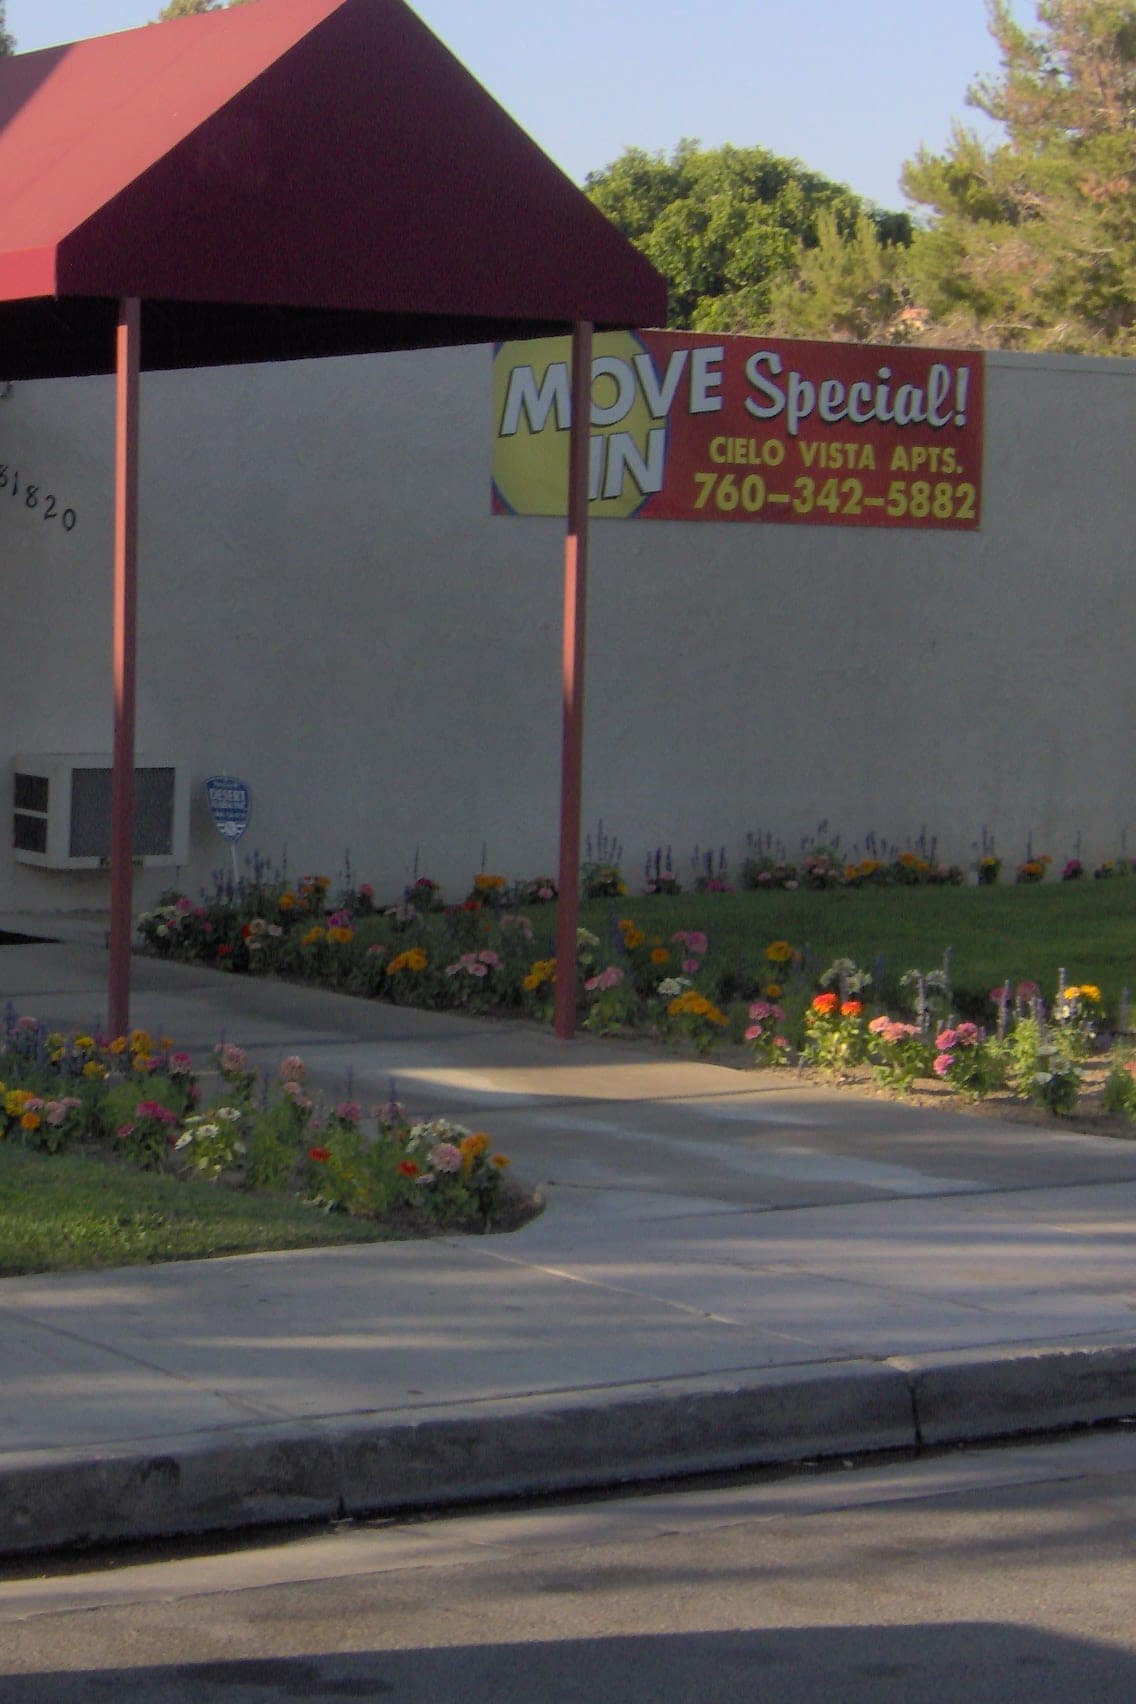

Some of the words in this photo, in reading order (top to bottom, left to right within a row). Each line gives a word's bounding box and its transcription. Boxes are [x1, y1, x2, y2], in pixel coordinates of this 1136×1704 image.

[499, 346, 725, 438] MOVE
[744, 351, 970, 436] Special!
[587, 428, 667, 501] IN
[710, 436, 785, 466] CIELO
[799, 441, 876, 471] VISTA
[890, 446, 963, 474] APTS.
[694, 473, 976, 519] 760-342-5882
